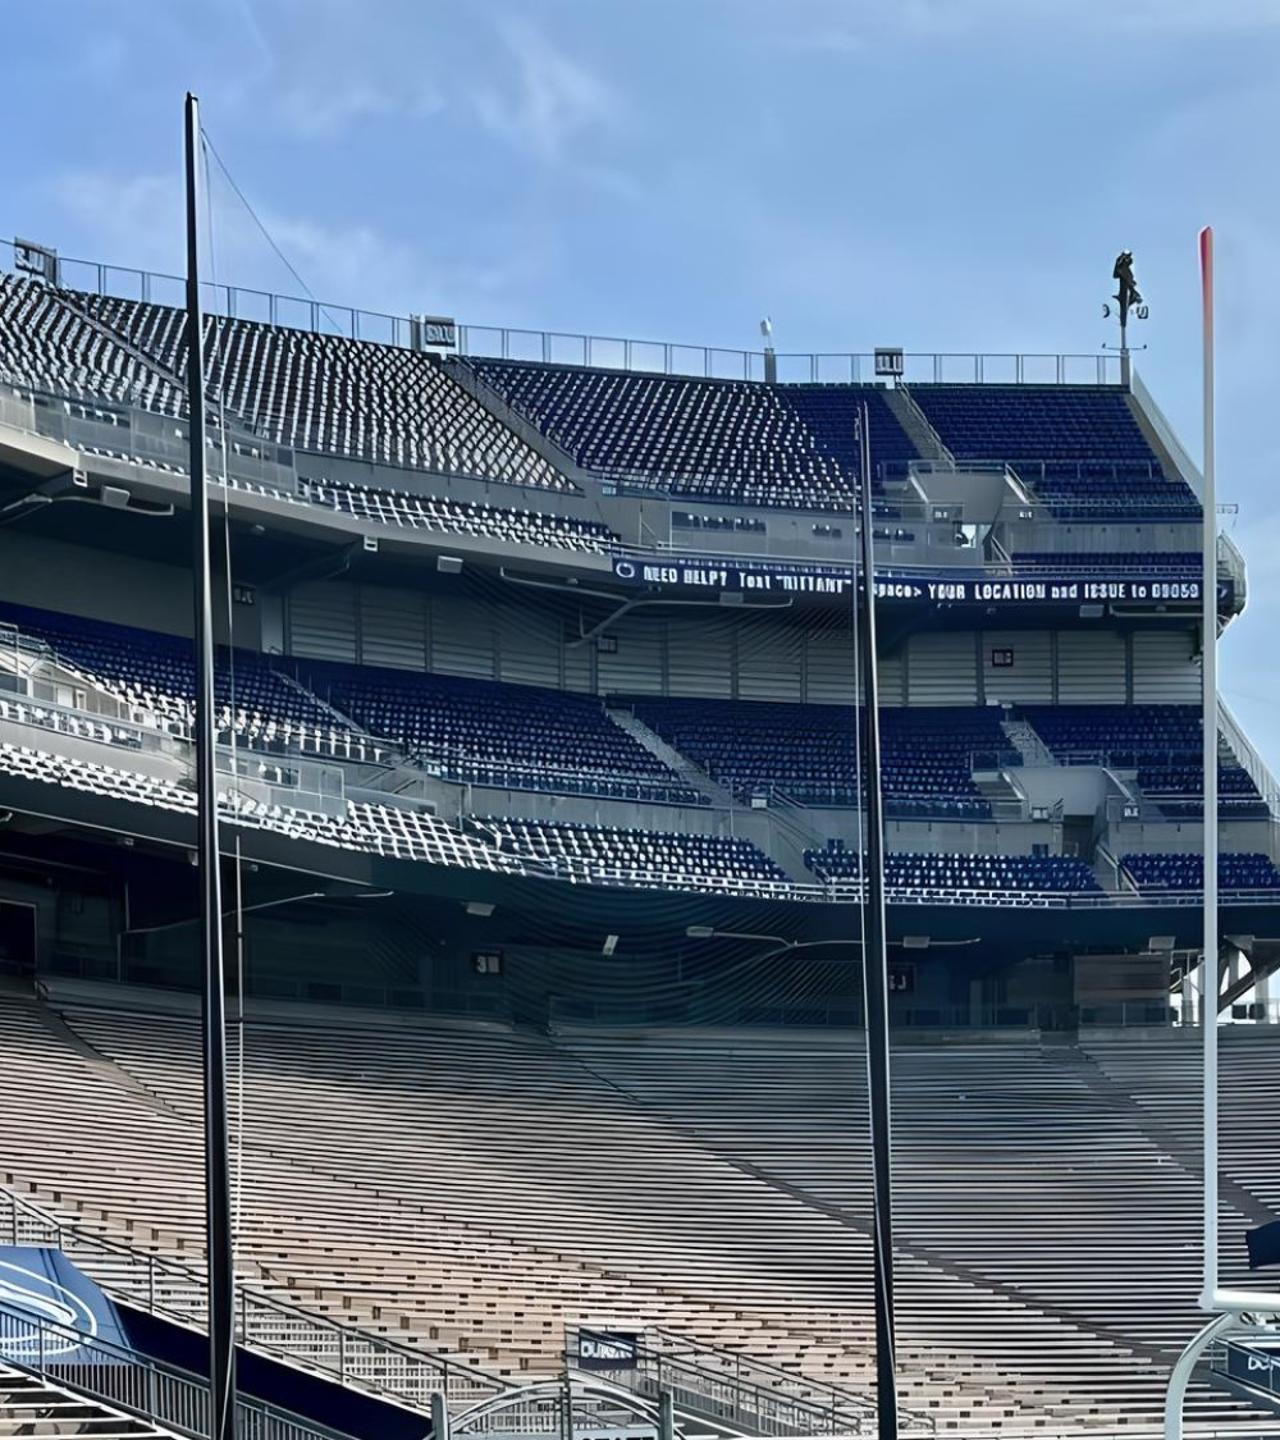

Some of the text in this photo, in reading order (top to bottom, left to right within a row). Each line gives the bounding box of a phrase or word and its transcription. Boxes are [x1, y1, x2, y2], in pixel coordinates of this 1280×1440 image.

[643, 566, 678, 583] NEED
[683, 568, 728, 587] HELP?
[928, 583, 966, 600] YOUR
[974, 583, 1046, 600] LOCATION
[1051, 584, 1078, 599] and
[1084, 583, 1126, 599] ISSUE
[1131, 584, 1147, 599] to
